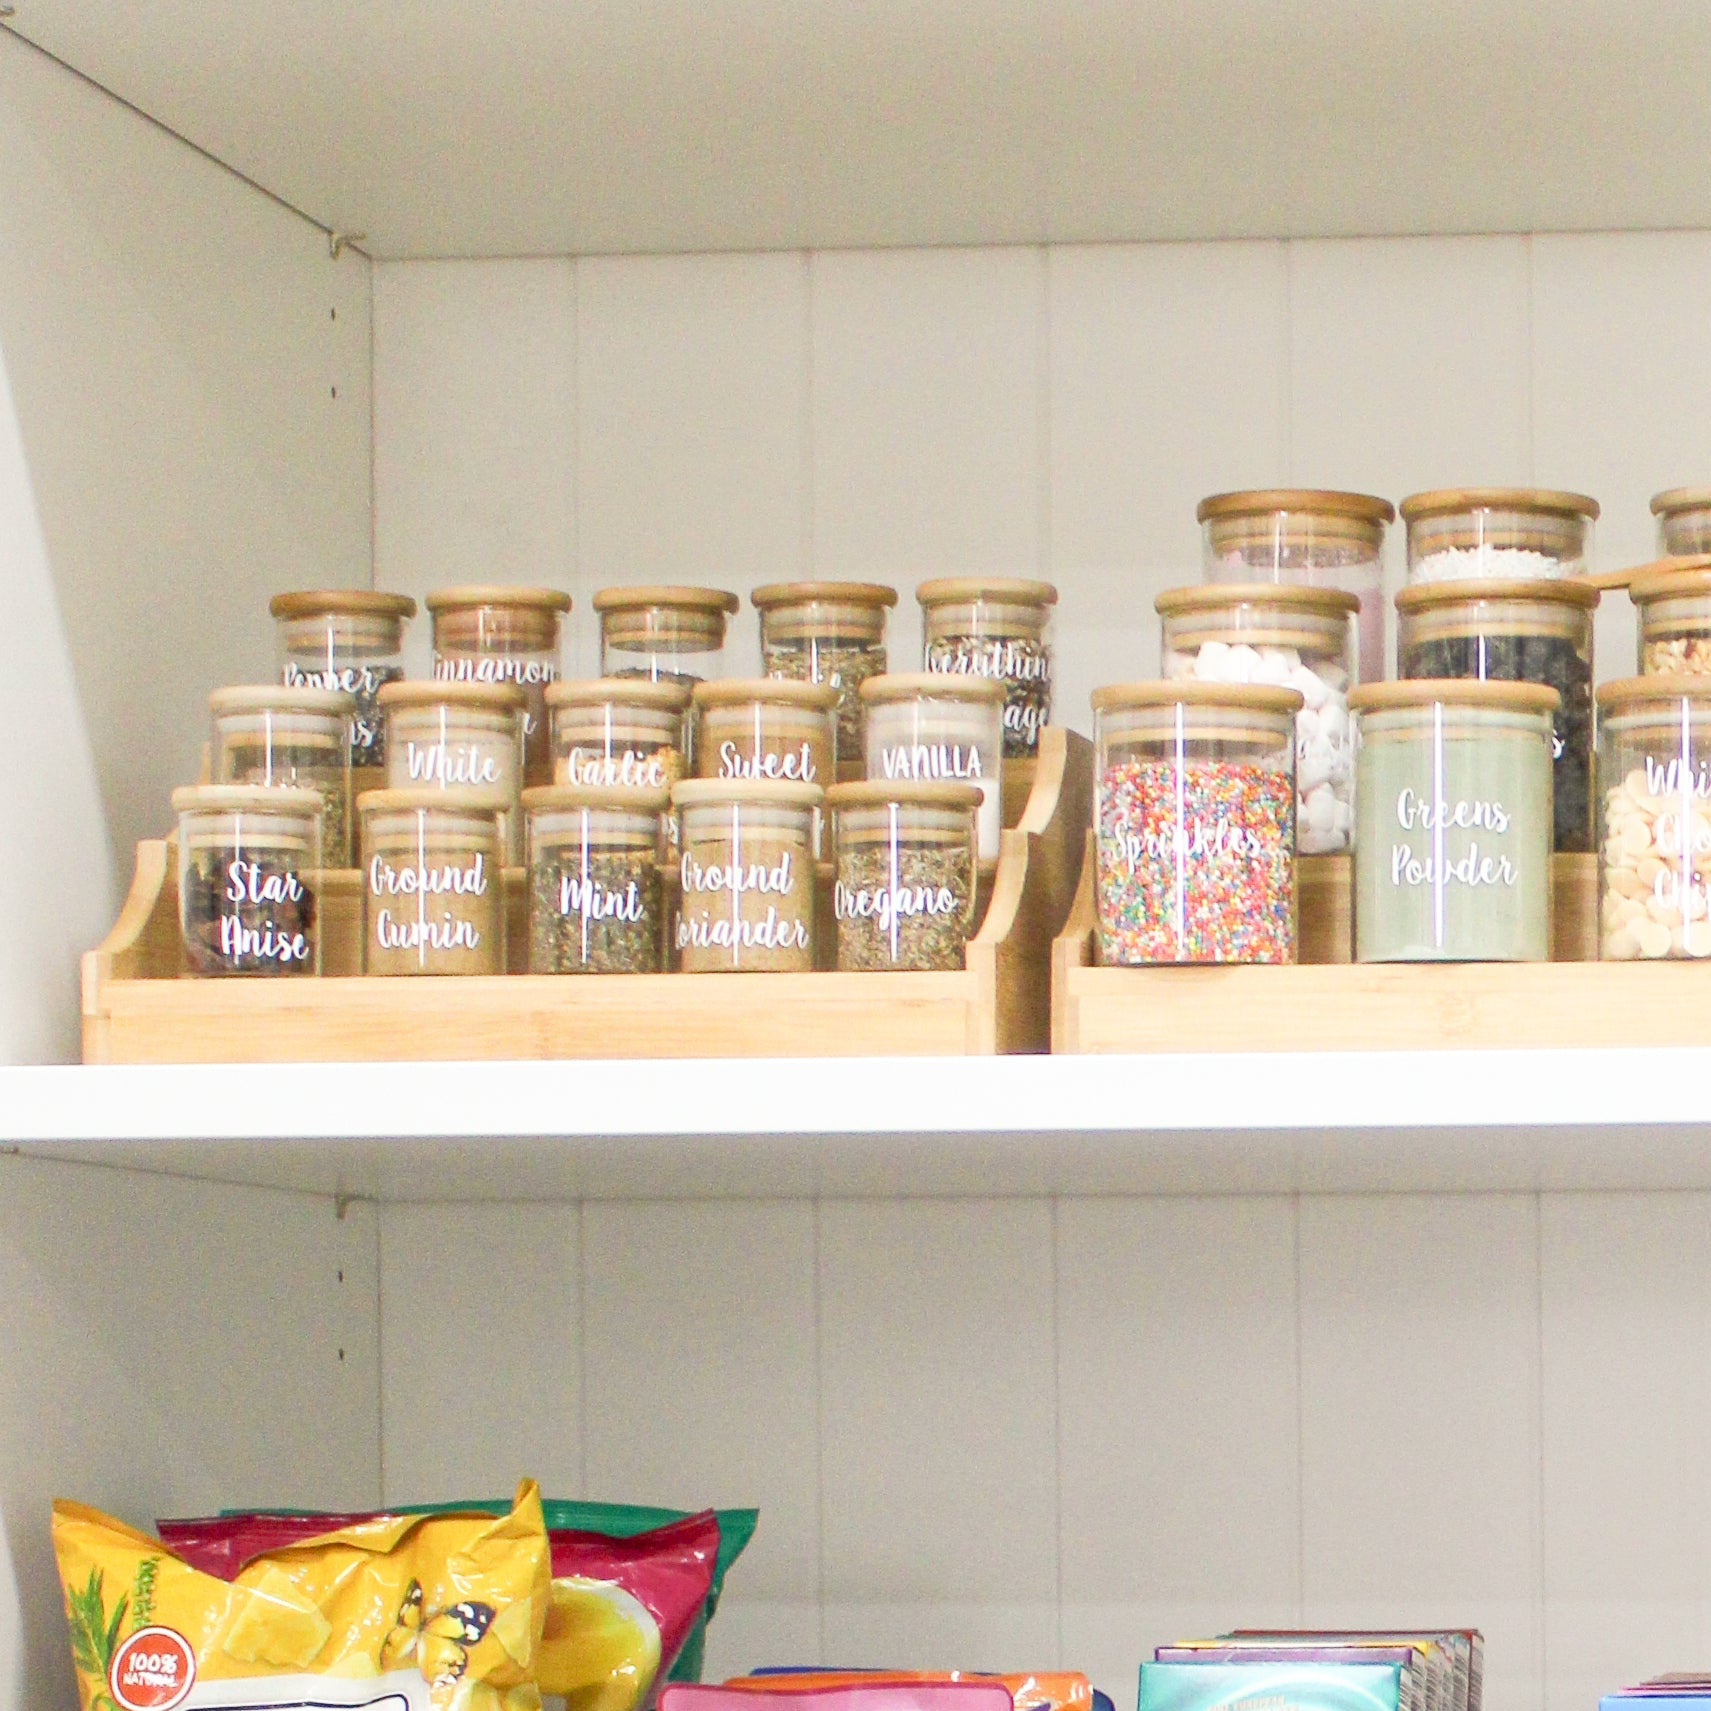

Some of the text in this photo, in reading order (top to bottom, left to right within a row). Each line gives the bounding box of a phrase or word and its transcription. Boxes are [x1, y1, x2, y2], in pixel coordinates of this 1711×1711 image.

[433, 653, 558, 684] innamon
[408, 742, 502, 785] White
[568, 746, 668, 788] Garlic
[719, 740, 817, 783] Sweet
[883, 744, 983, 779] VANILLA
[1397, 787, 1512, 833] Greens
[1111, 816, 1263, 874] Sprinkles
[1391, 842, 1519, 887] Powder
[227, 861, 304, 905] Star
[370, 853, 488, 897] Ground
[682, 852, 795, 896] Ground
[559, 876, 645, 923] Mint
[835, 881, 958, 932] Oregano
[220, 914, 310, 961] Anise
[378, 909, 481, 950] Cumin
[676, 907, 809, 950] oriander
[129, 1652, 178, 1674] 100%
